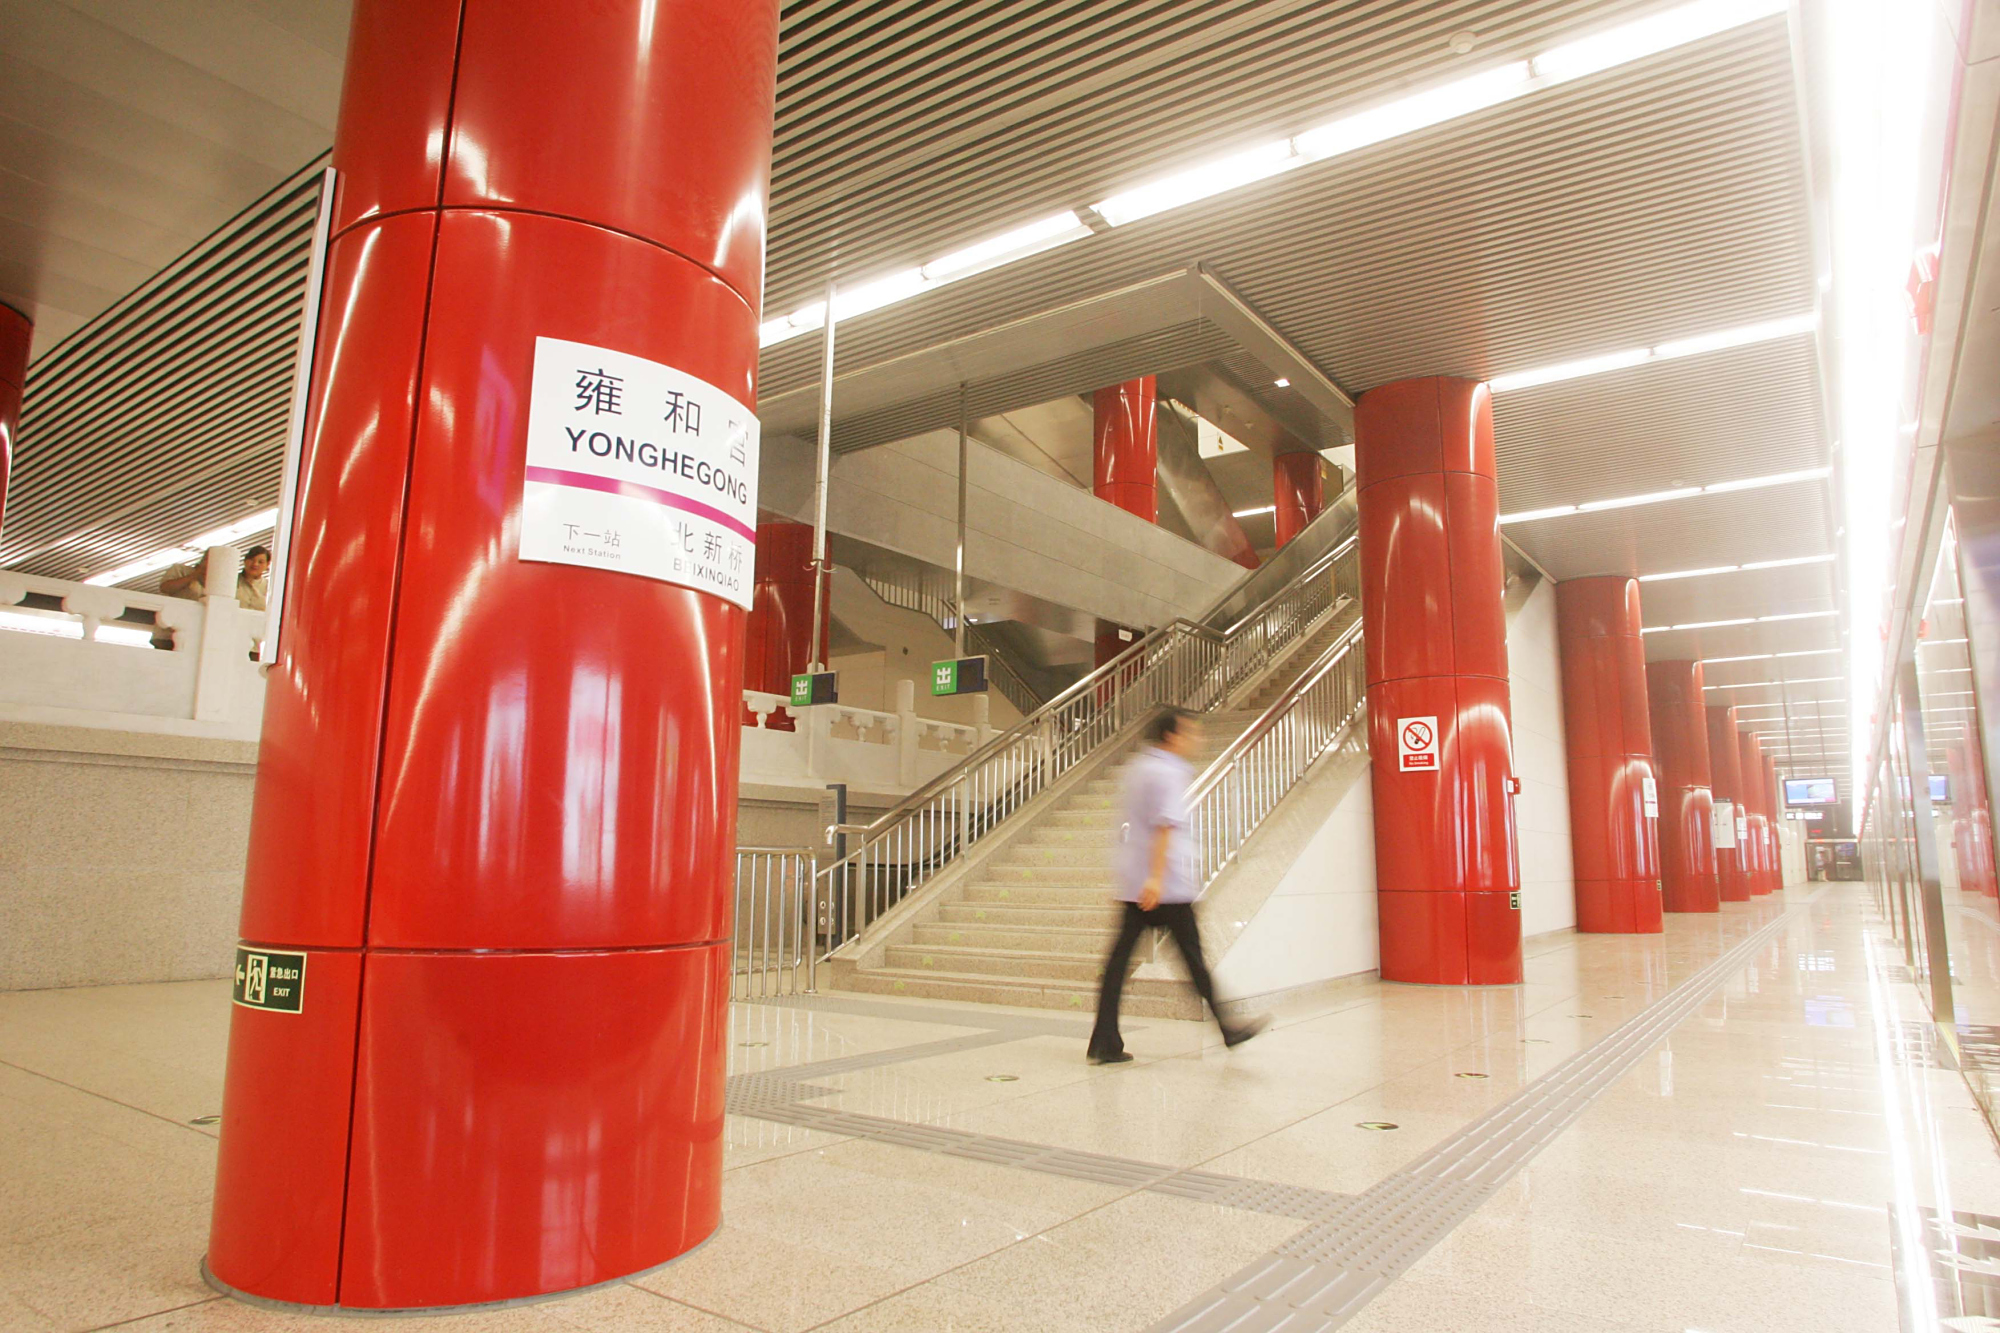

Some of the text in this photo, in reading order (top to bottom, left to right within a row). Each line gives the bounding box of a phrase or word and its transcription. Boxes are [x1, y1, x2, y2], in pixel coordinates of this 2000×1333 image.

[565, 427, 748, 505] YONGHEGONG
[563, 523, 621, 547] 下一站
[563, 545, 621, 560] Next Station
[937, 667, 950, 684] 出
[796, 680, 807, 695] 出
[273, 987, 290, 997] EXIT
